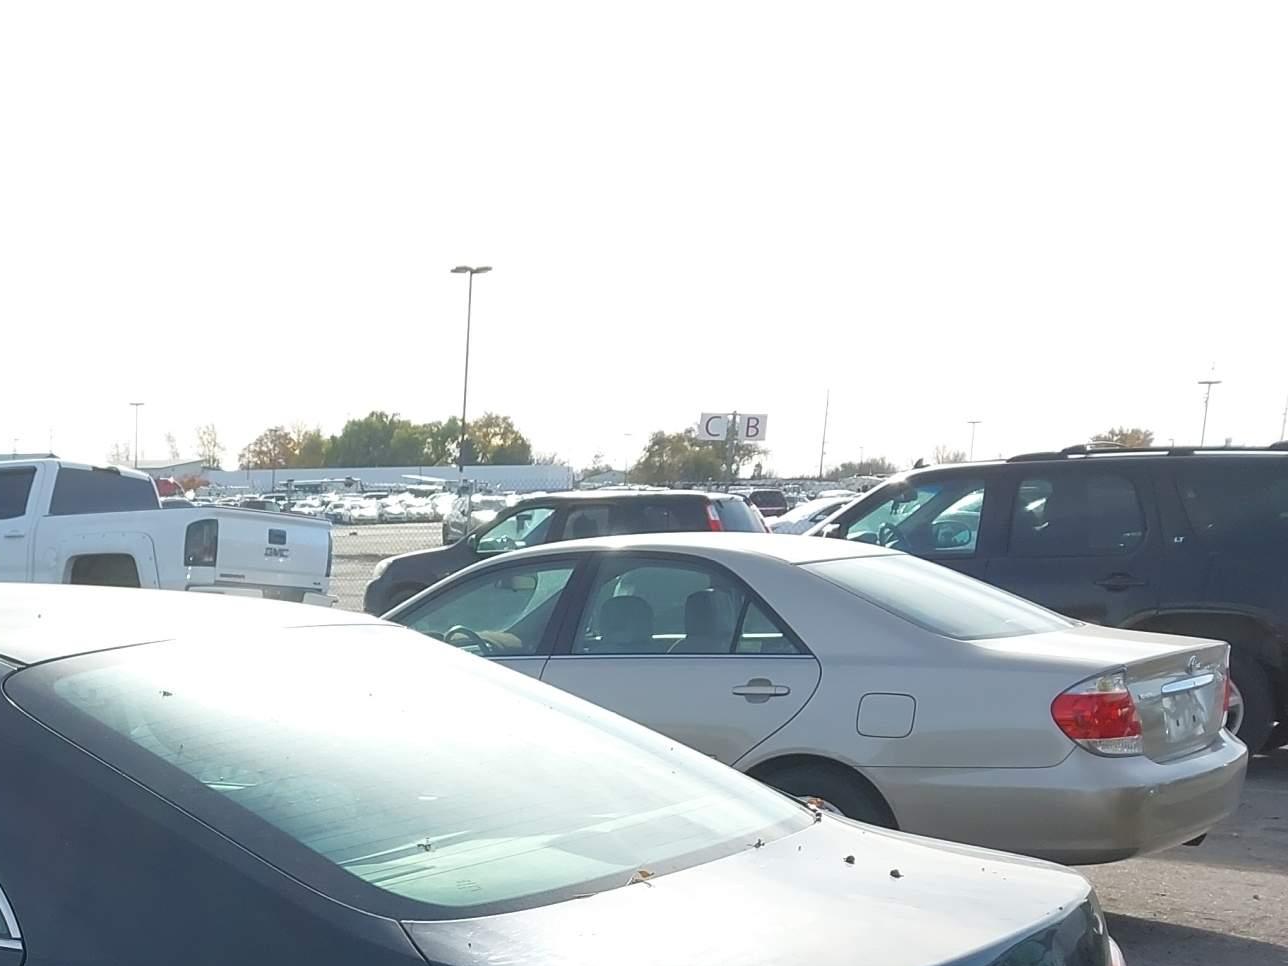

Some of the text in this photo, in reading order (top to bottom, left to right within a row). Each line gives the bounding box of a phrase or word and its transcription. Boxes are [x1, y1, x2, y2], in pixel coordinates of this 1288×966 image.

[705, 416, 722, 437] C
[746, 417, 760, 438] B
[264, 547, 289, 558] GMC
